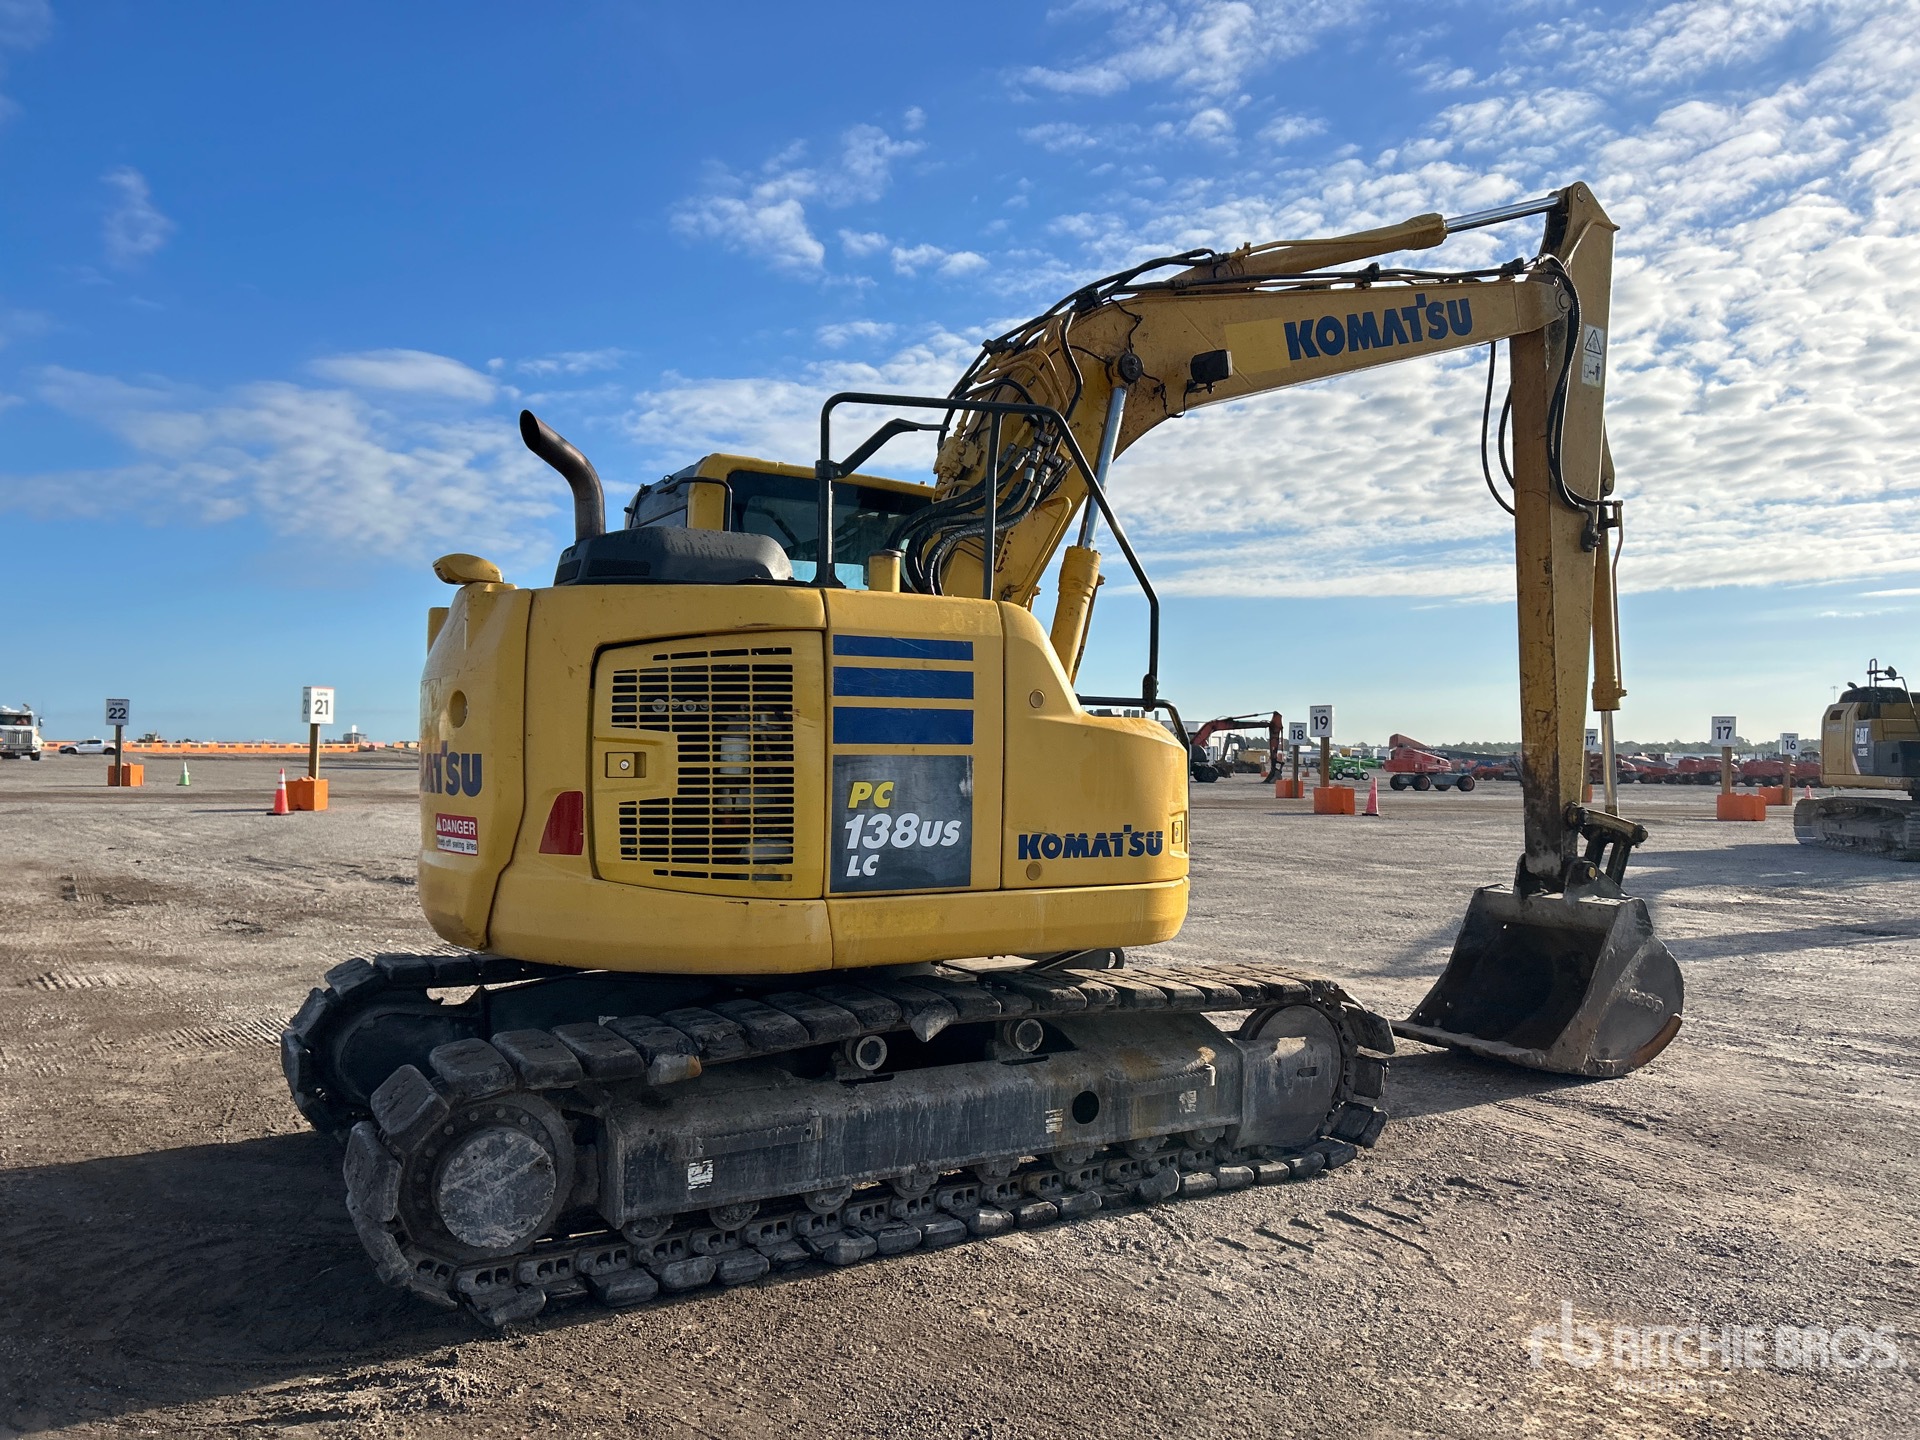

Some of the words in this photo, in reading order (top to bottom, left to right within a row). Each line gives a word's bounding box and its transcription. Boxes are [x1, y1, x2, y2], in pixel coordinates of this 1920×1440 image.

[1284, 293, 1474, 361] KOMATSU
[108, 707, 126, 719] 22
[315, 699, 329, 715] 21
[1313, 715, 1329, 730] 19
[1292, 729, 1304, 740] 18
[1585, 735, 1596, 746] 17
[1716, 726, 1732, 739] 17
[1855, 727, 1869, 745] CAT
[1785, 740, 1797, 750] 16
[847, 781, 895, 809] PC
[442, 818, 476, 836] DANGER
[1018, 824, 1163, 860] KOMATSU
[846, 855, 880, 877] LC
